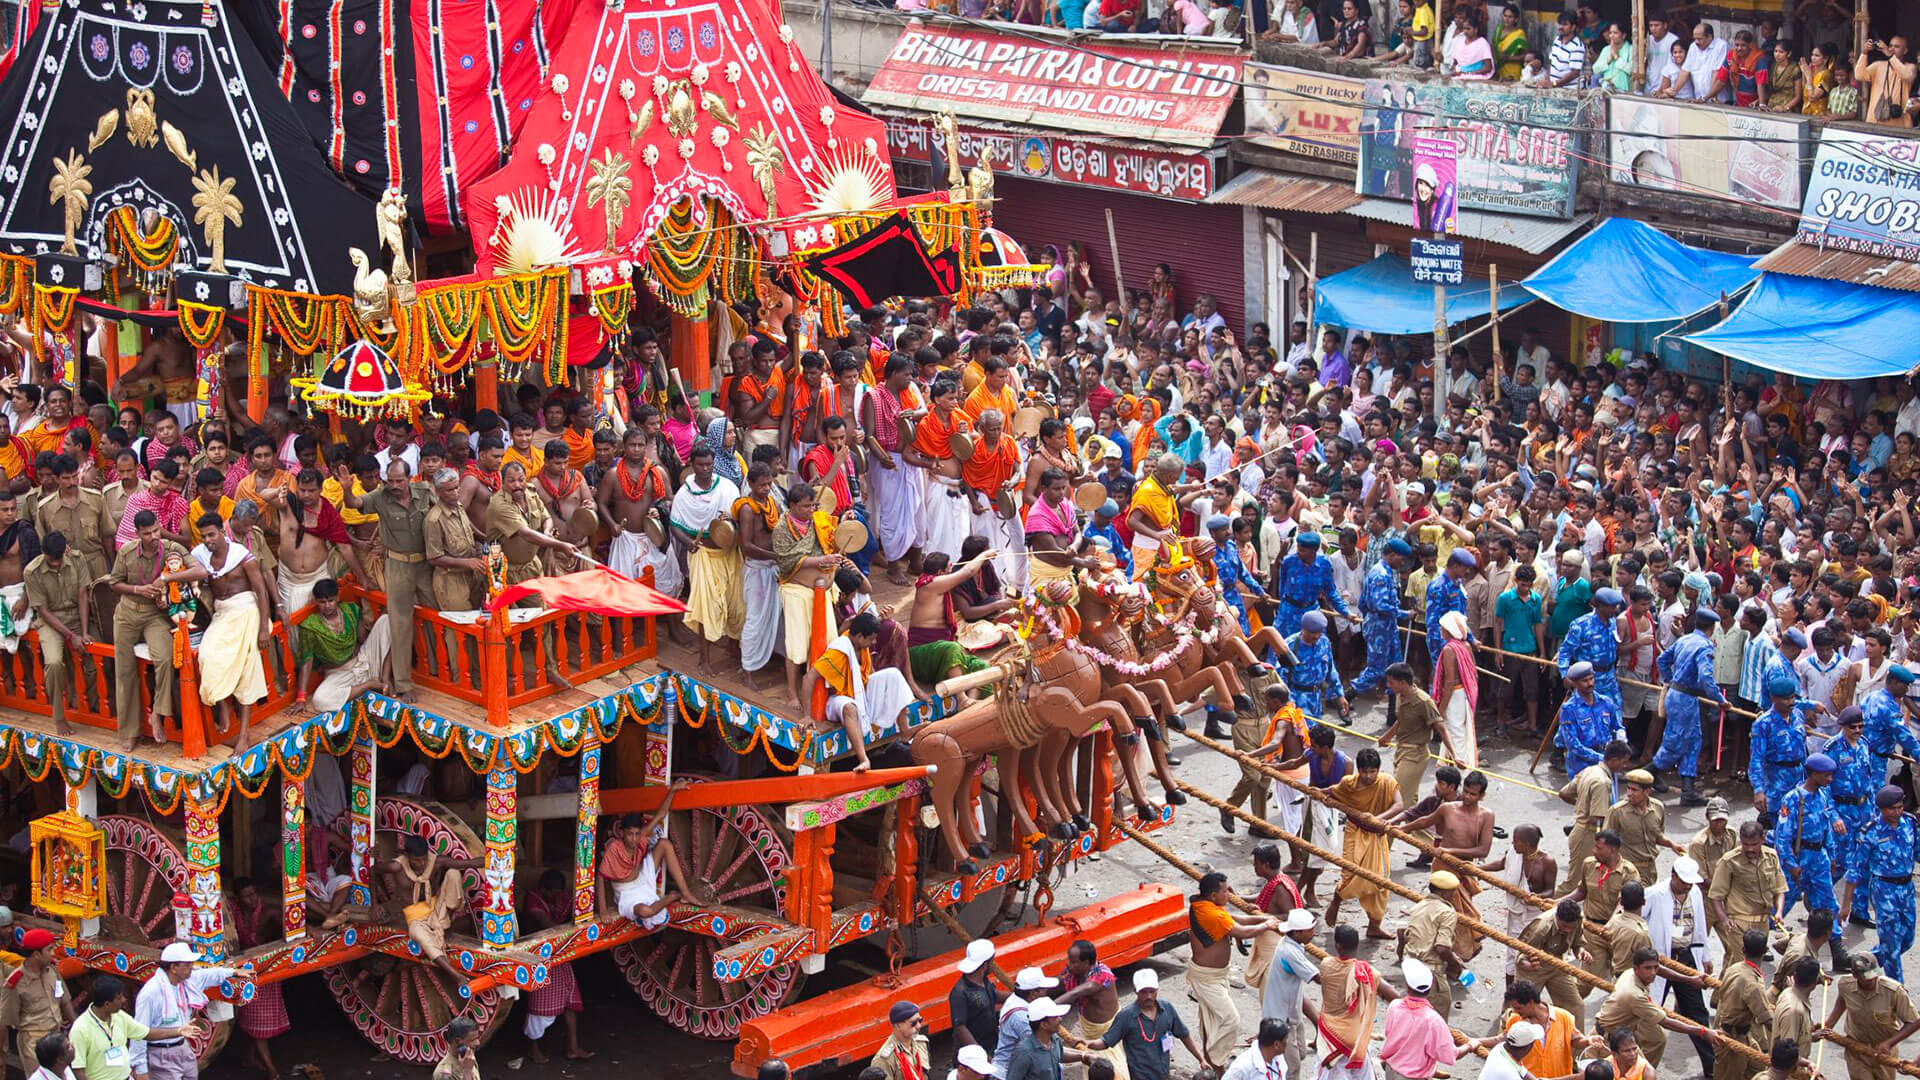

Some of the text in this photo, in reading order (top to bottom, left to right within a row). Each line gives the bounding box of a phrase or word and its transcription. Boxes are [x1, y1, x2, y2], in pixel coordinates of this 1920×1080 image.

[892, 31, 986, 72] BHIMA
[982, 43, 1085, 83] PATRA
[918, 74, 1174, 121] ORISSA HANDLOOMS
[1326, 86, 1358, 99] lucky
[1298, 110, 1352, 133] LUX
[1289, 141, 1358, 161] BASTRASHREE
[1517, 125, 1569, 169] SREE
[1821, 159, 1890, 187] ORISSA
[1477, 192, 1506, 205] Grand
[1536, 201, 1556, 211] Puri
[1816, 187, 1920, 233] SHOB
